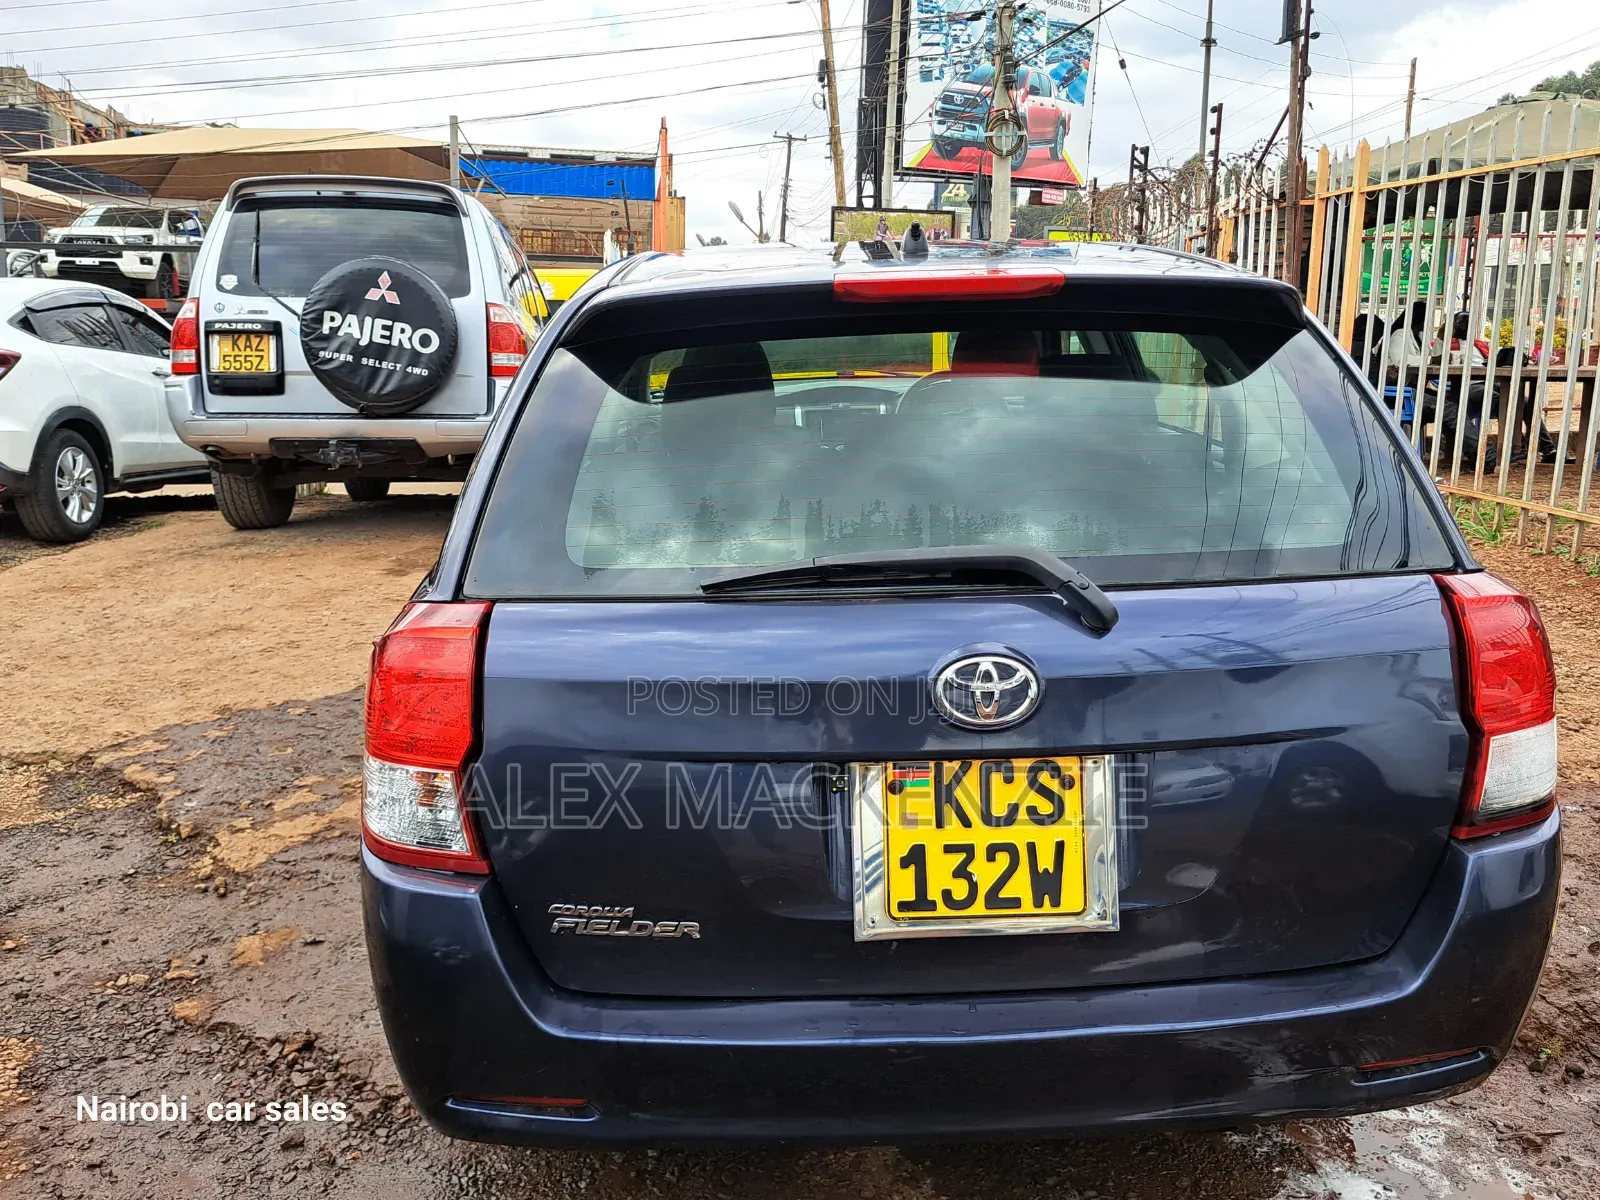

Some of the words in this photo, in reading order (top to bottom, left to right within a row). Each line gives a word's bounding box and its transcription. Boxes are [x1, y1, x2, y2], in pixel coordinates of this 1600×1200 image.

[231, 334, 265, 353] KAZ
[322, 310, 440, 354] PAJERO
[222, 354, 265, 371] 555Z
[318, 350, 354, 363] SUPER
[361, 357, 402, 371] SELECT
[406, 366, 429, 377] 4WD
[933, 758, 1066, 830] KCS
[896, 838, 1066, 913] 132W
[547, 903, 635, 918] COROLLA
[549, 917, 701, 939] FIELDER
